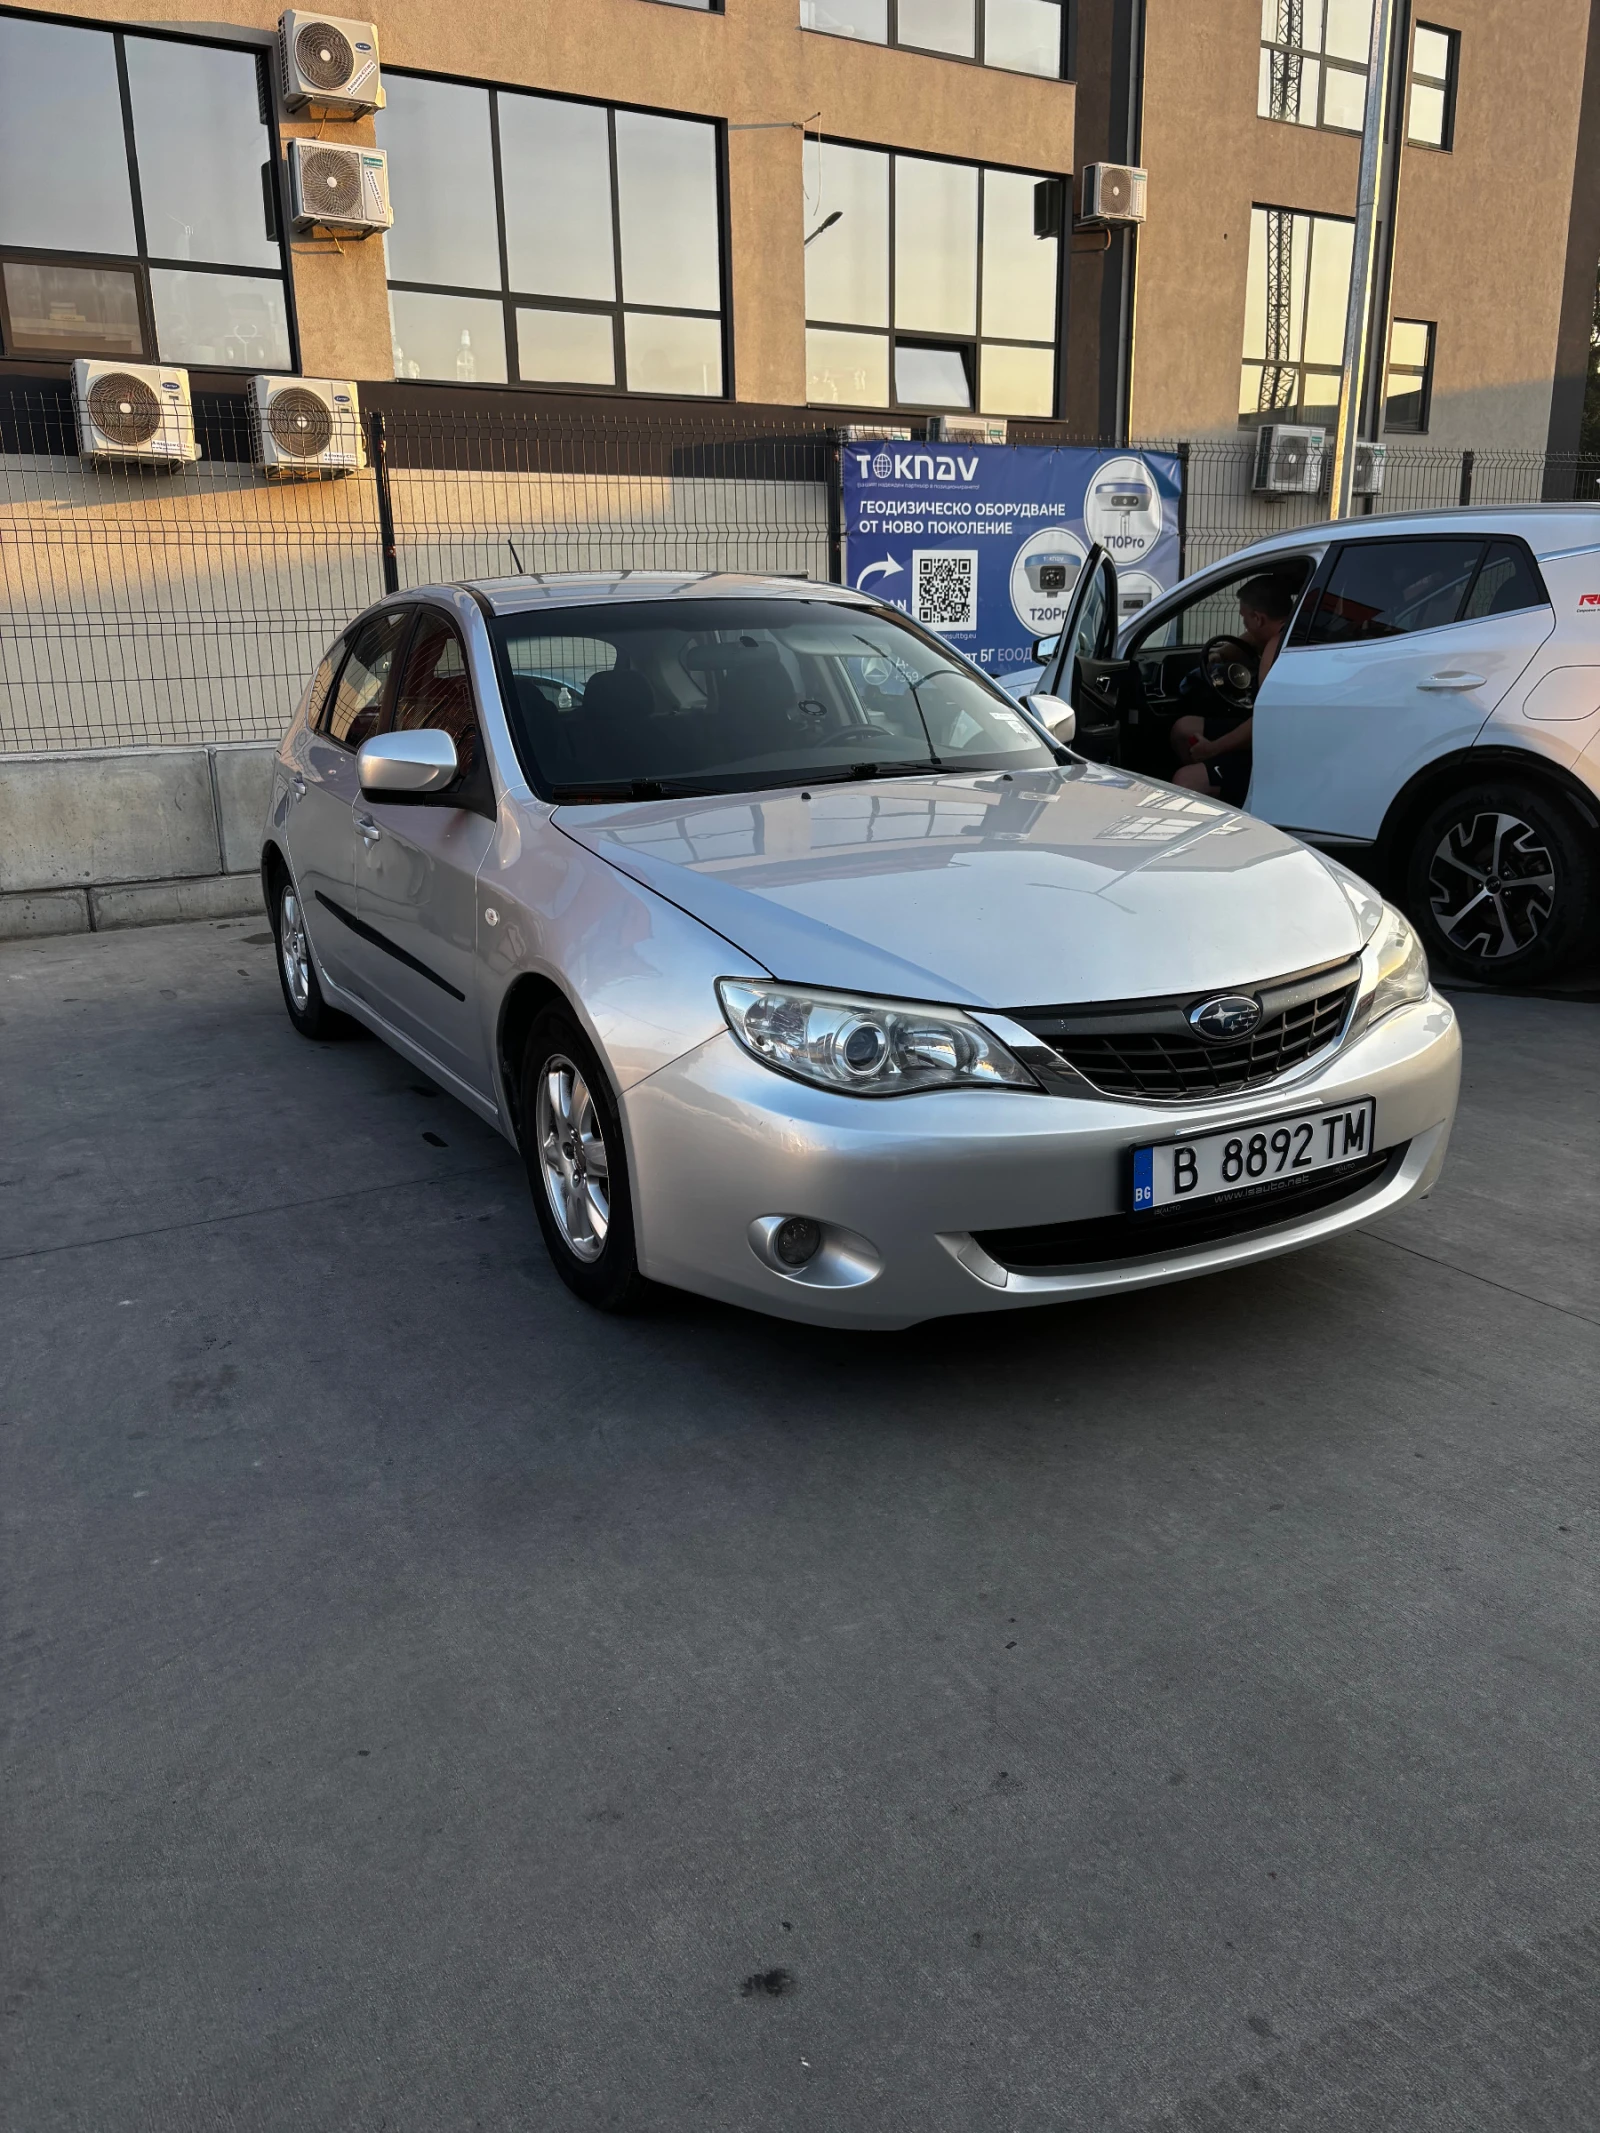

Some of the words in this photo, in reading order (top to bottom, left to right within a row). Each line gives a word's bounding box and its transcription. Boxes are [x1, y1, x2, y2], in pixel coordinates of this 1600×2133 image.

[859, 500, 972, 516] ГЕОДИЗИЧЕСКО
[975, 503, 1066, 518] ОБОРУДВАНЕ
[859, 520, 878, 533] ОТ
[882, 520, 924, 533] НОВО
[928, 521, 1013, 534] ПОКОЛЕНИЕ
[1103, 536, 1145, 548] T10Pro
[1029, 607, 1066, 620] T20Pr
[980, 648, 995, 662] БГ
[997, 647, 1032, 663] ЕООД
[1174, 1147, 1198, 1195] B
[1222, 1122, 1314, 1183] 8892
[1322, 1108, 1366, 1159] TM
[1135, 1186, 1151, 1202] BG
[1214, 1174, 1310, 1203] www.isauto.net
